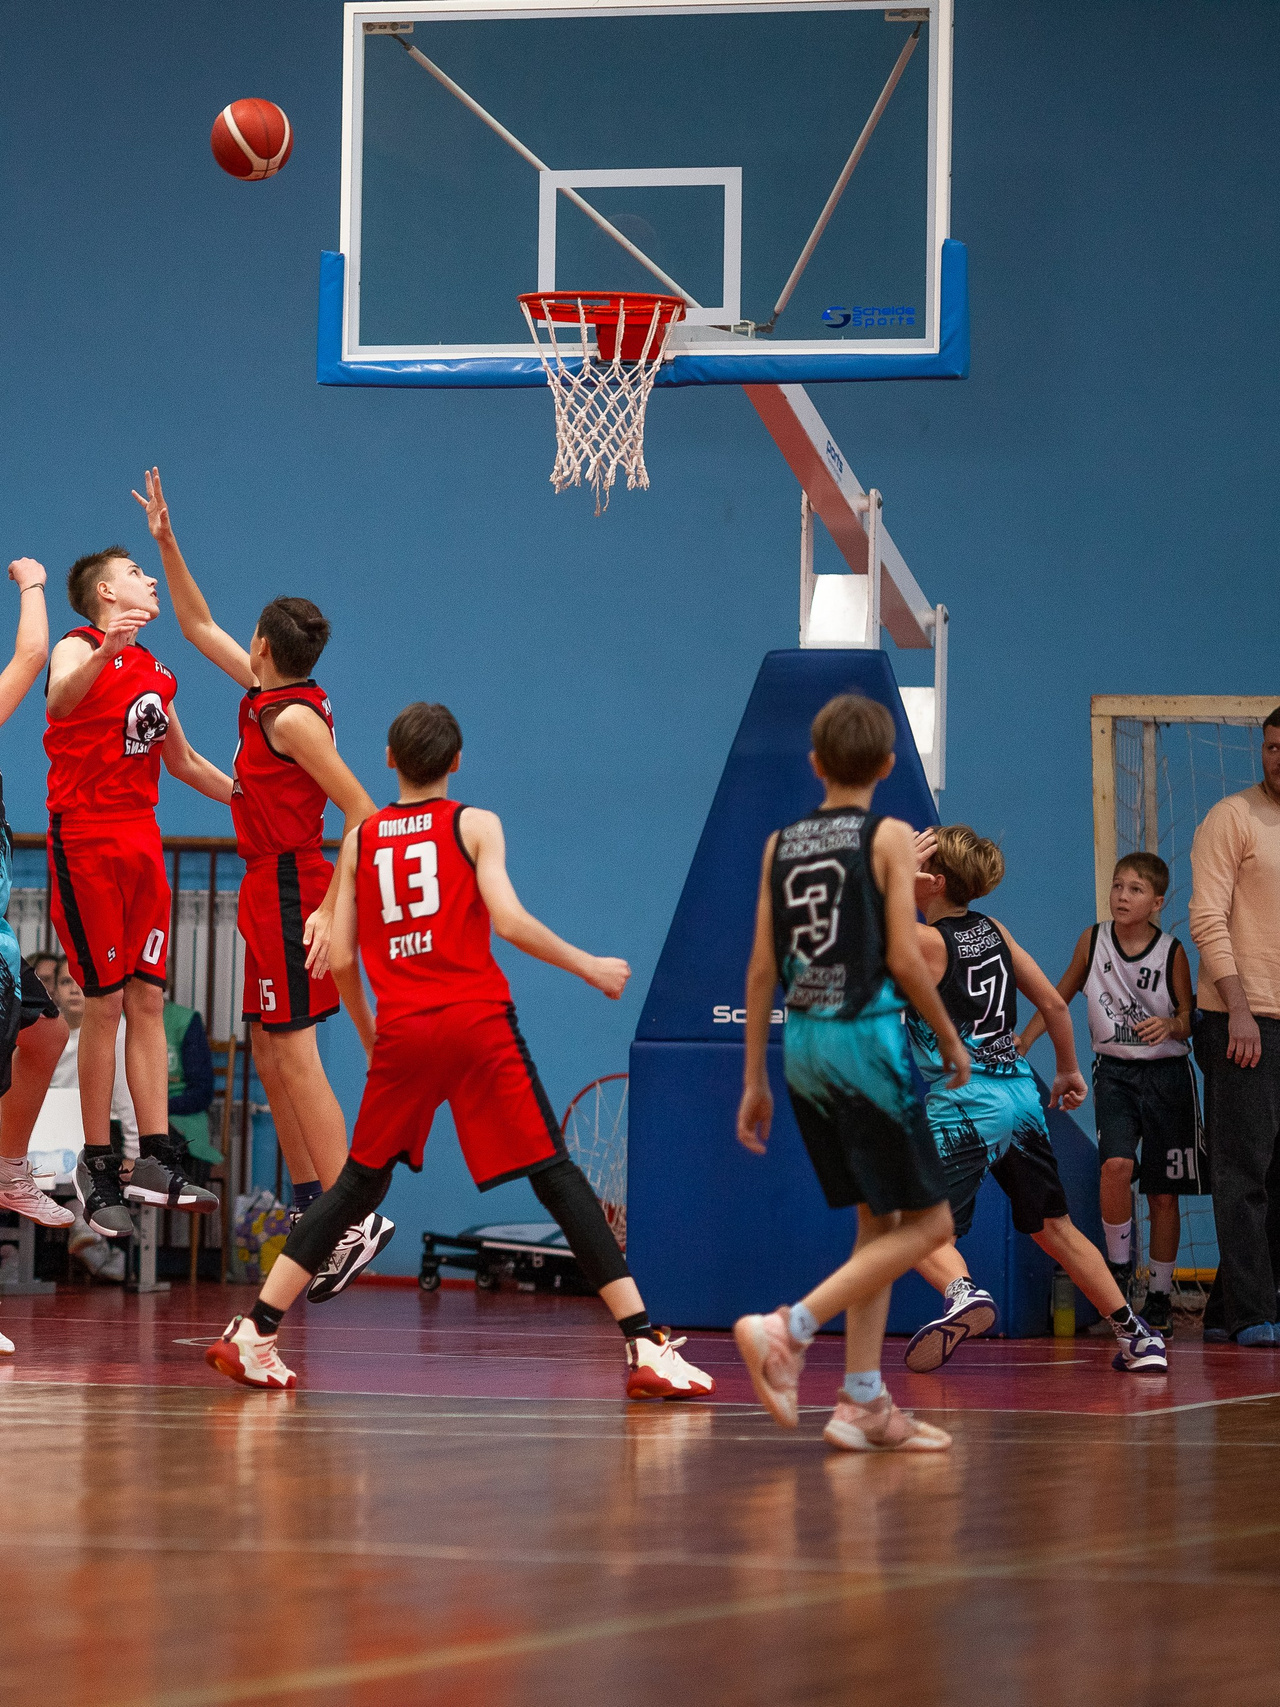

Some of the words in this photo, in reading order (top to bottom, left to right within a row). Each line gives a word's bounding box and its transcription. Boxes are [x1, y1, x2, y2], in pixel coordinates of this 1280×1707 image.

[852, 316, 916, 328] Sports
[378, 813, 433, 838] ПИКАЕВ
[373, 840, 441, 924] 13
[784, 859, 846, 966] 3
[141, 927, 165, 965] 0
[258, 978, 277, 1012] 15
[1136, 966, 1161, 992] 31
[967, 954, 1009, 1040] 7
[1166, 1147, 1196, 1180] 31
